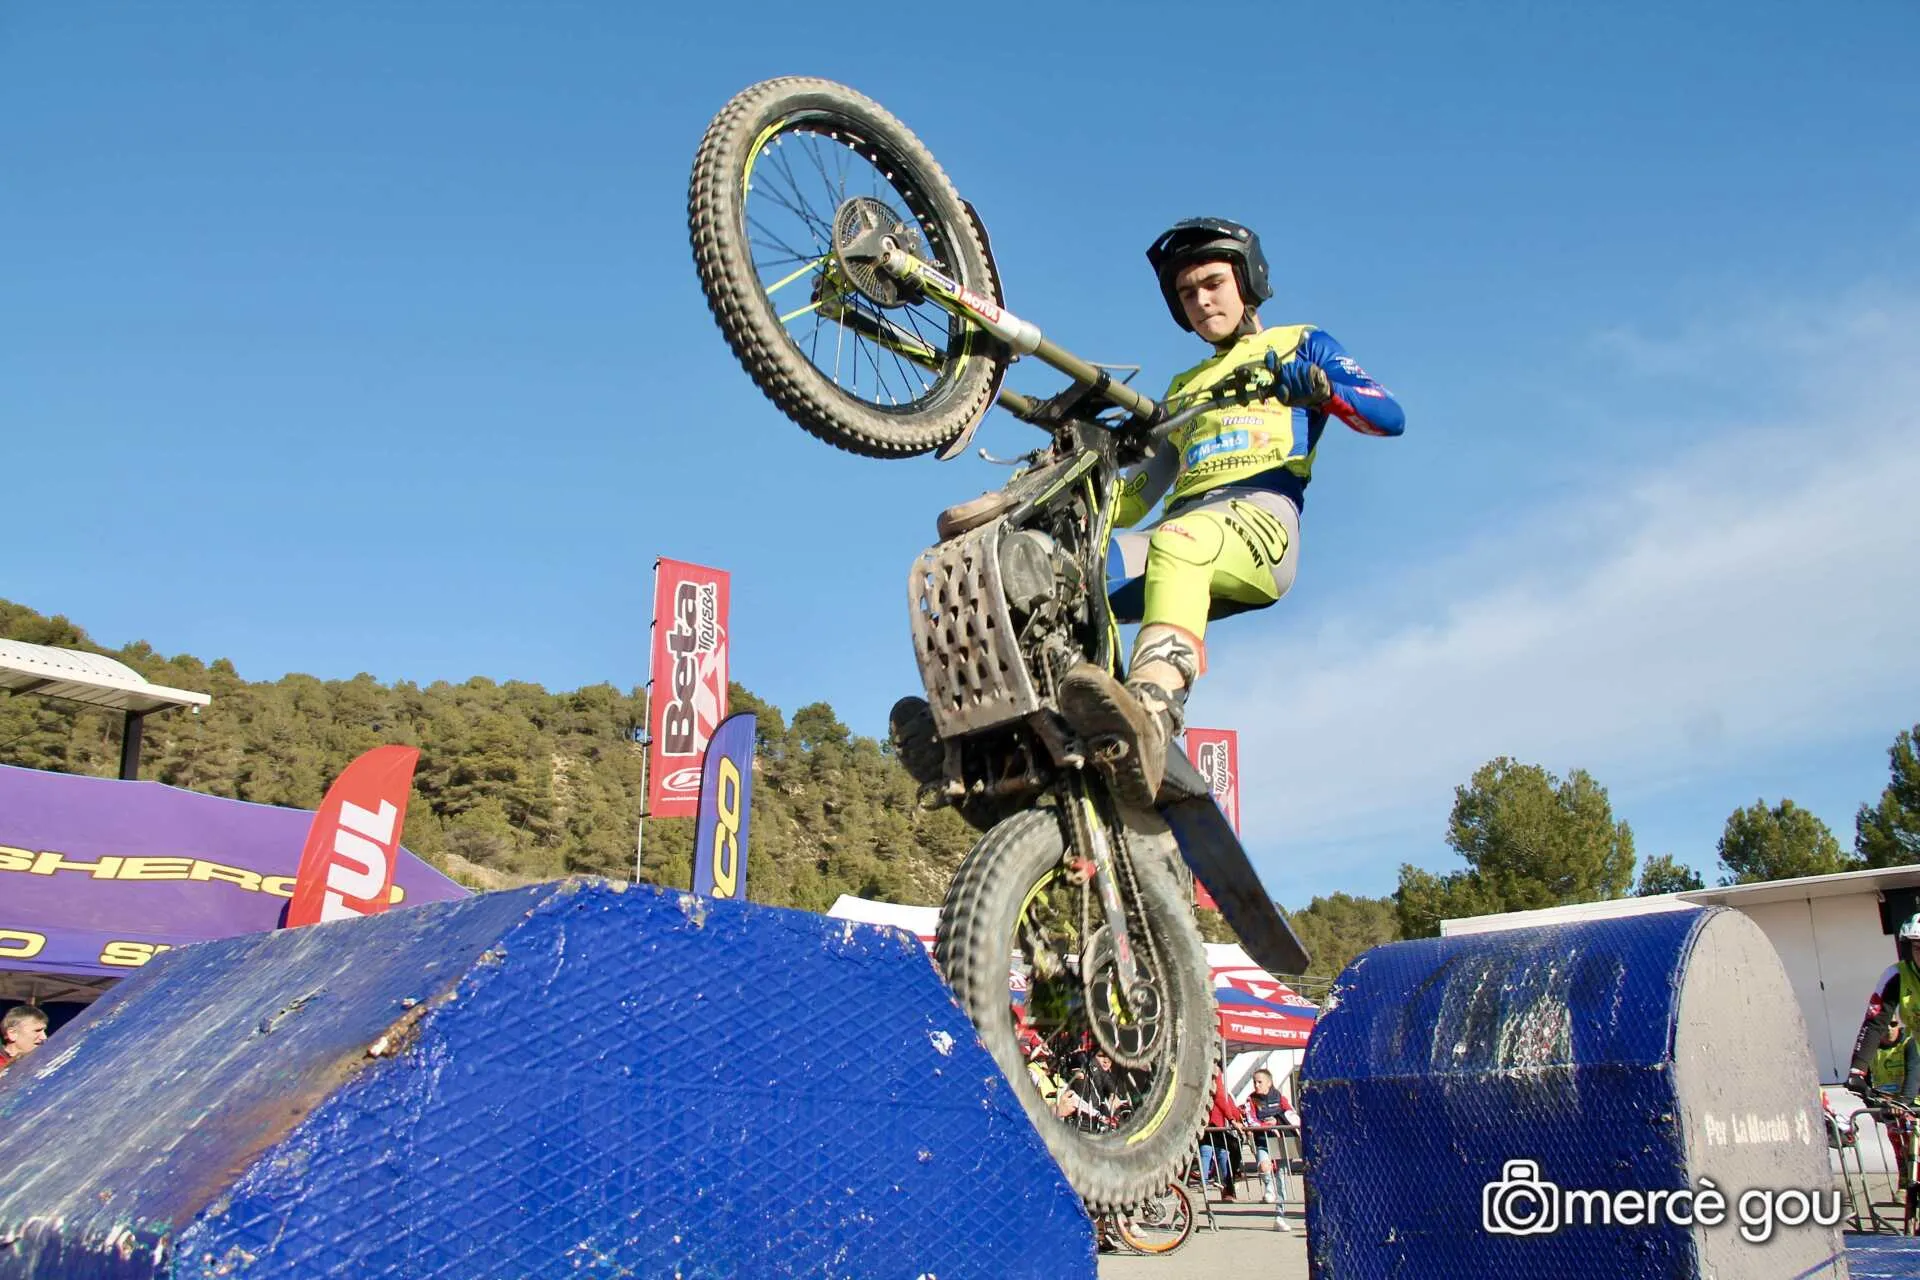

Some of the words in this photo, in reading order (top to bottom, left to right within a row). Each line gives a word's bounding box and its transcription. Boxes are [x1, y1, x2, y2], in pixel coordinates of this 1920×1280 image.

[960, 290, 999, 322] MOTUL
[662, 582, 698, 756] Beta
[712, 756, 740, 898] CO
